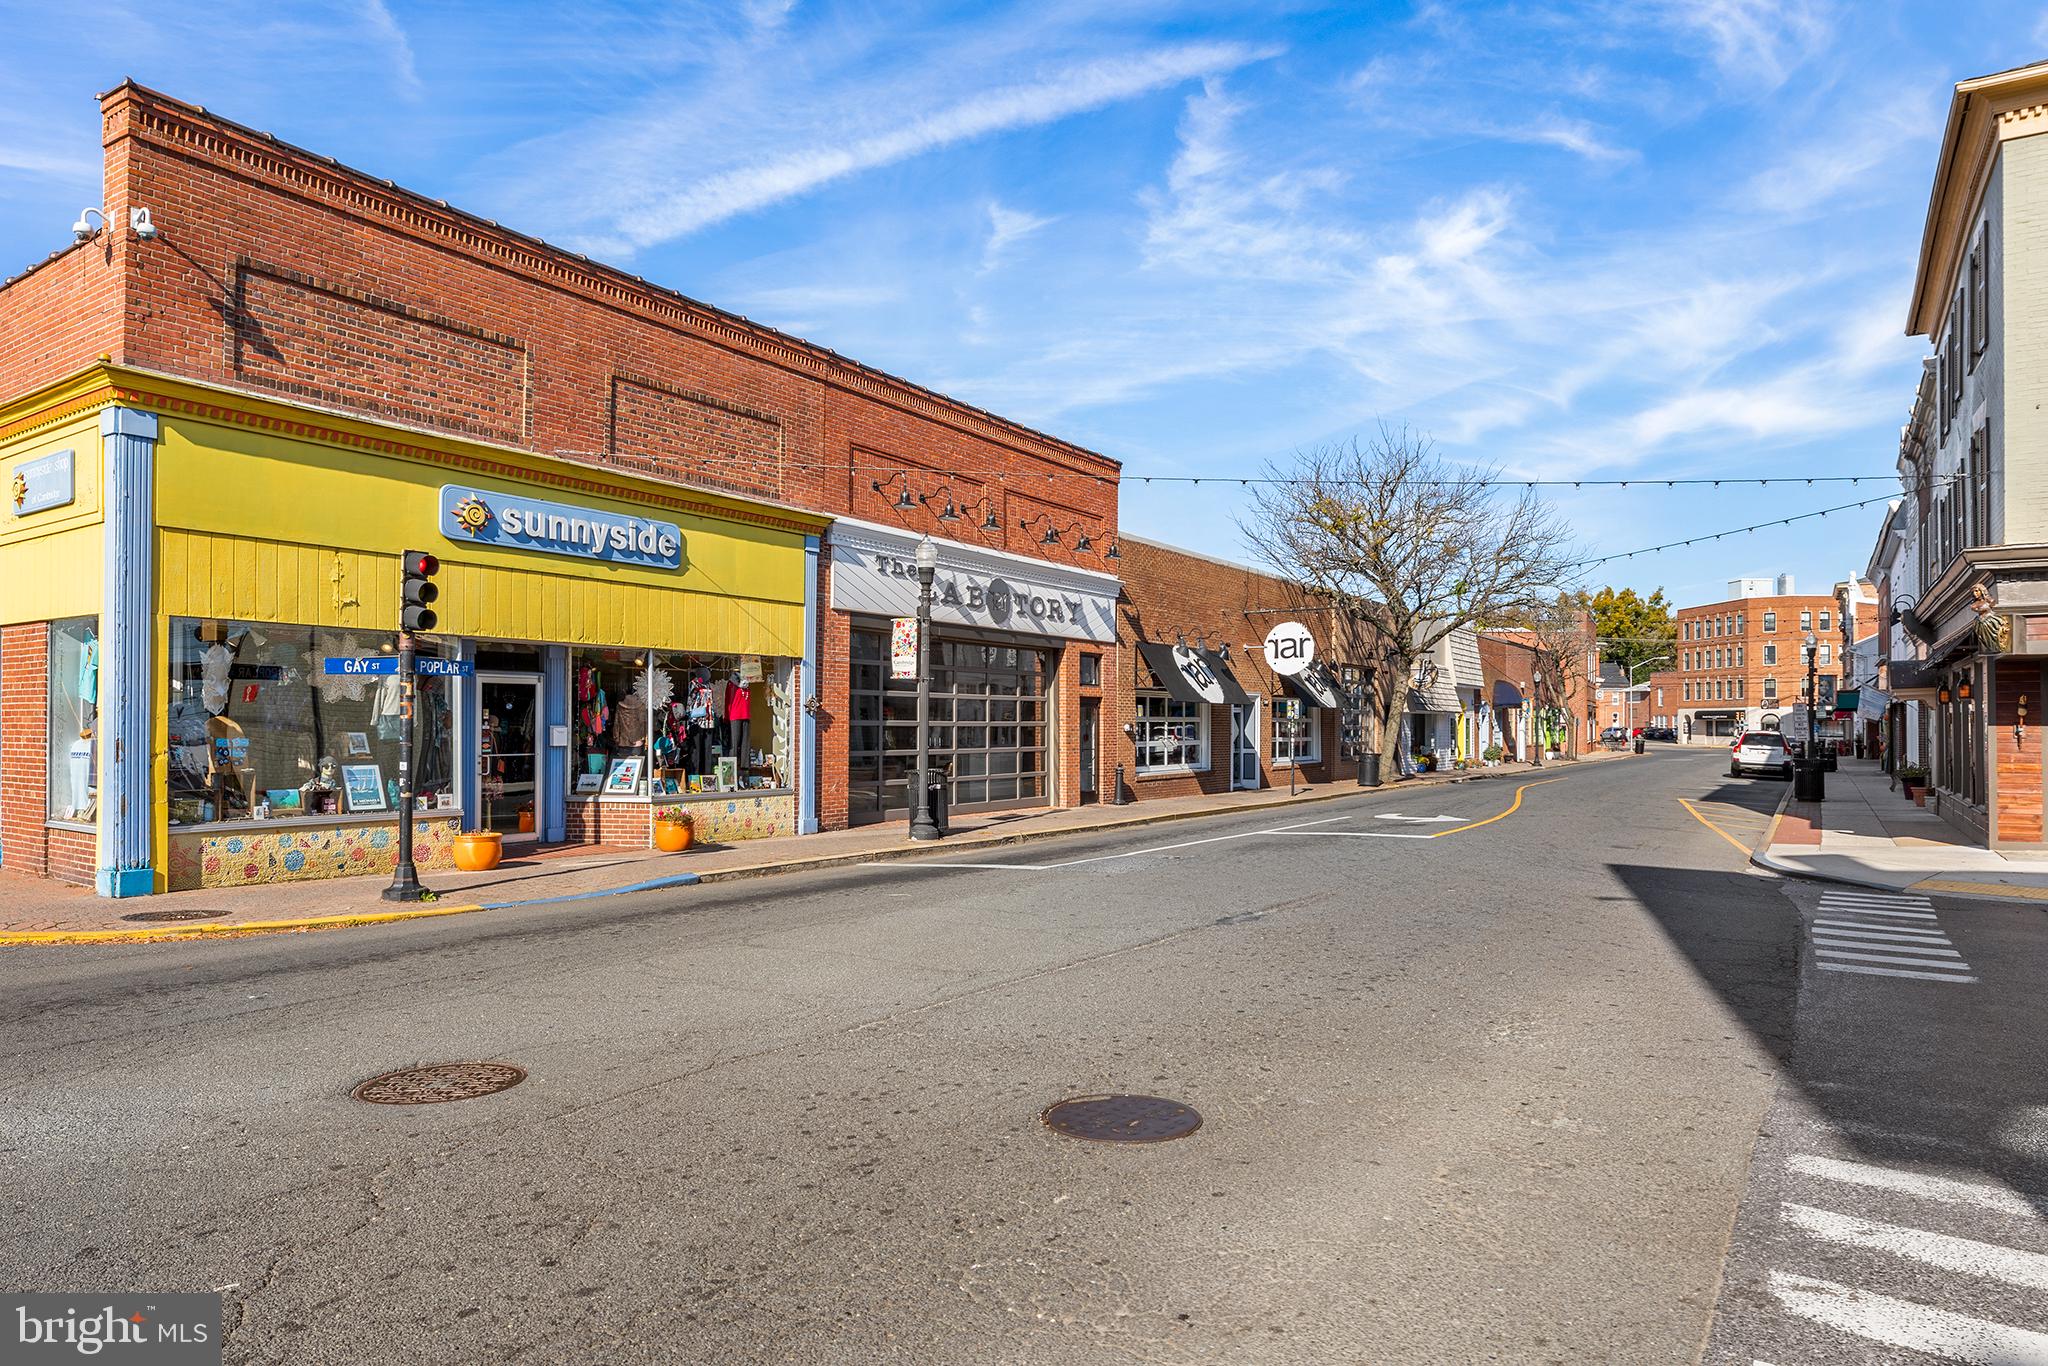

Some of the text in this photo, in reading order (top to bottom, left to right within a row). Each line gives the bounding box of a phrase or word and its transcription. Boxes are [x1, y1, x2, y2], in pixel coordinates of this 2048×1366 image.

[501, 507, 676, 557] sunnyside
[875, 555, 918, 578] The
[344, 660, 380, 672] GAY ST
[420, 661, 459, 674] POPLAR
